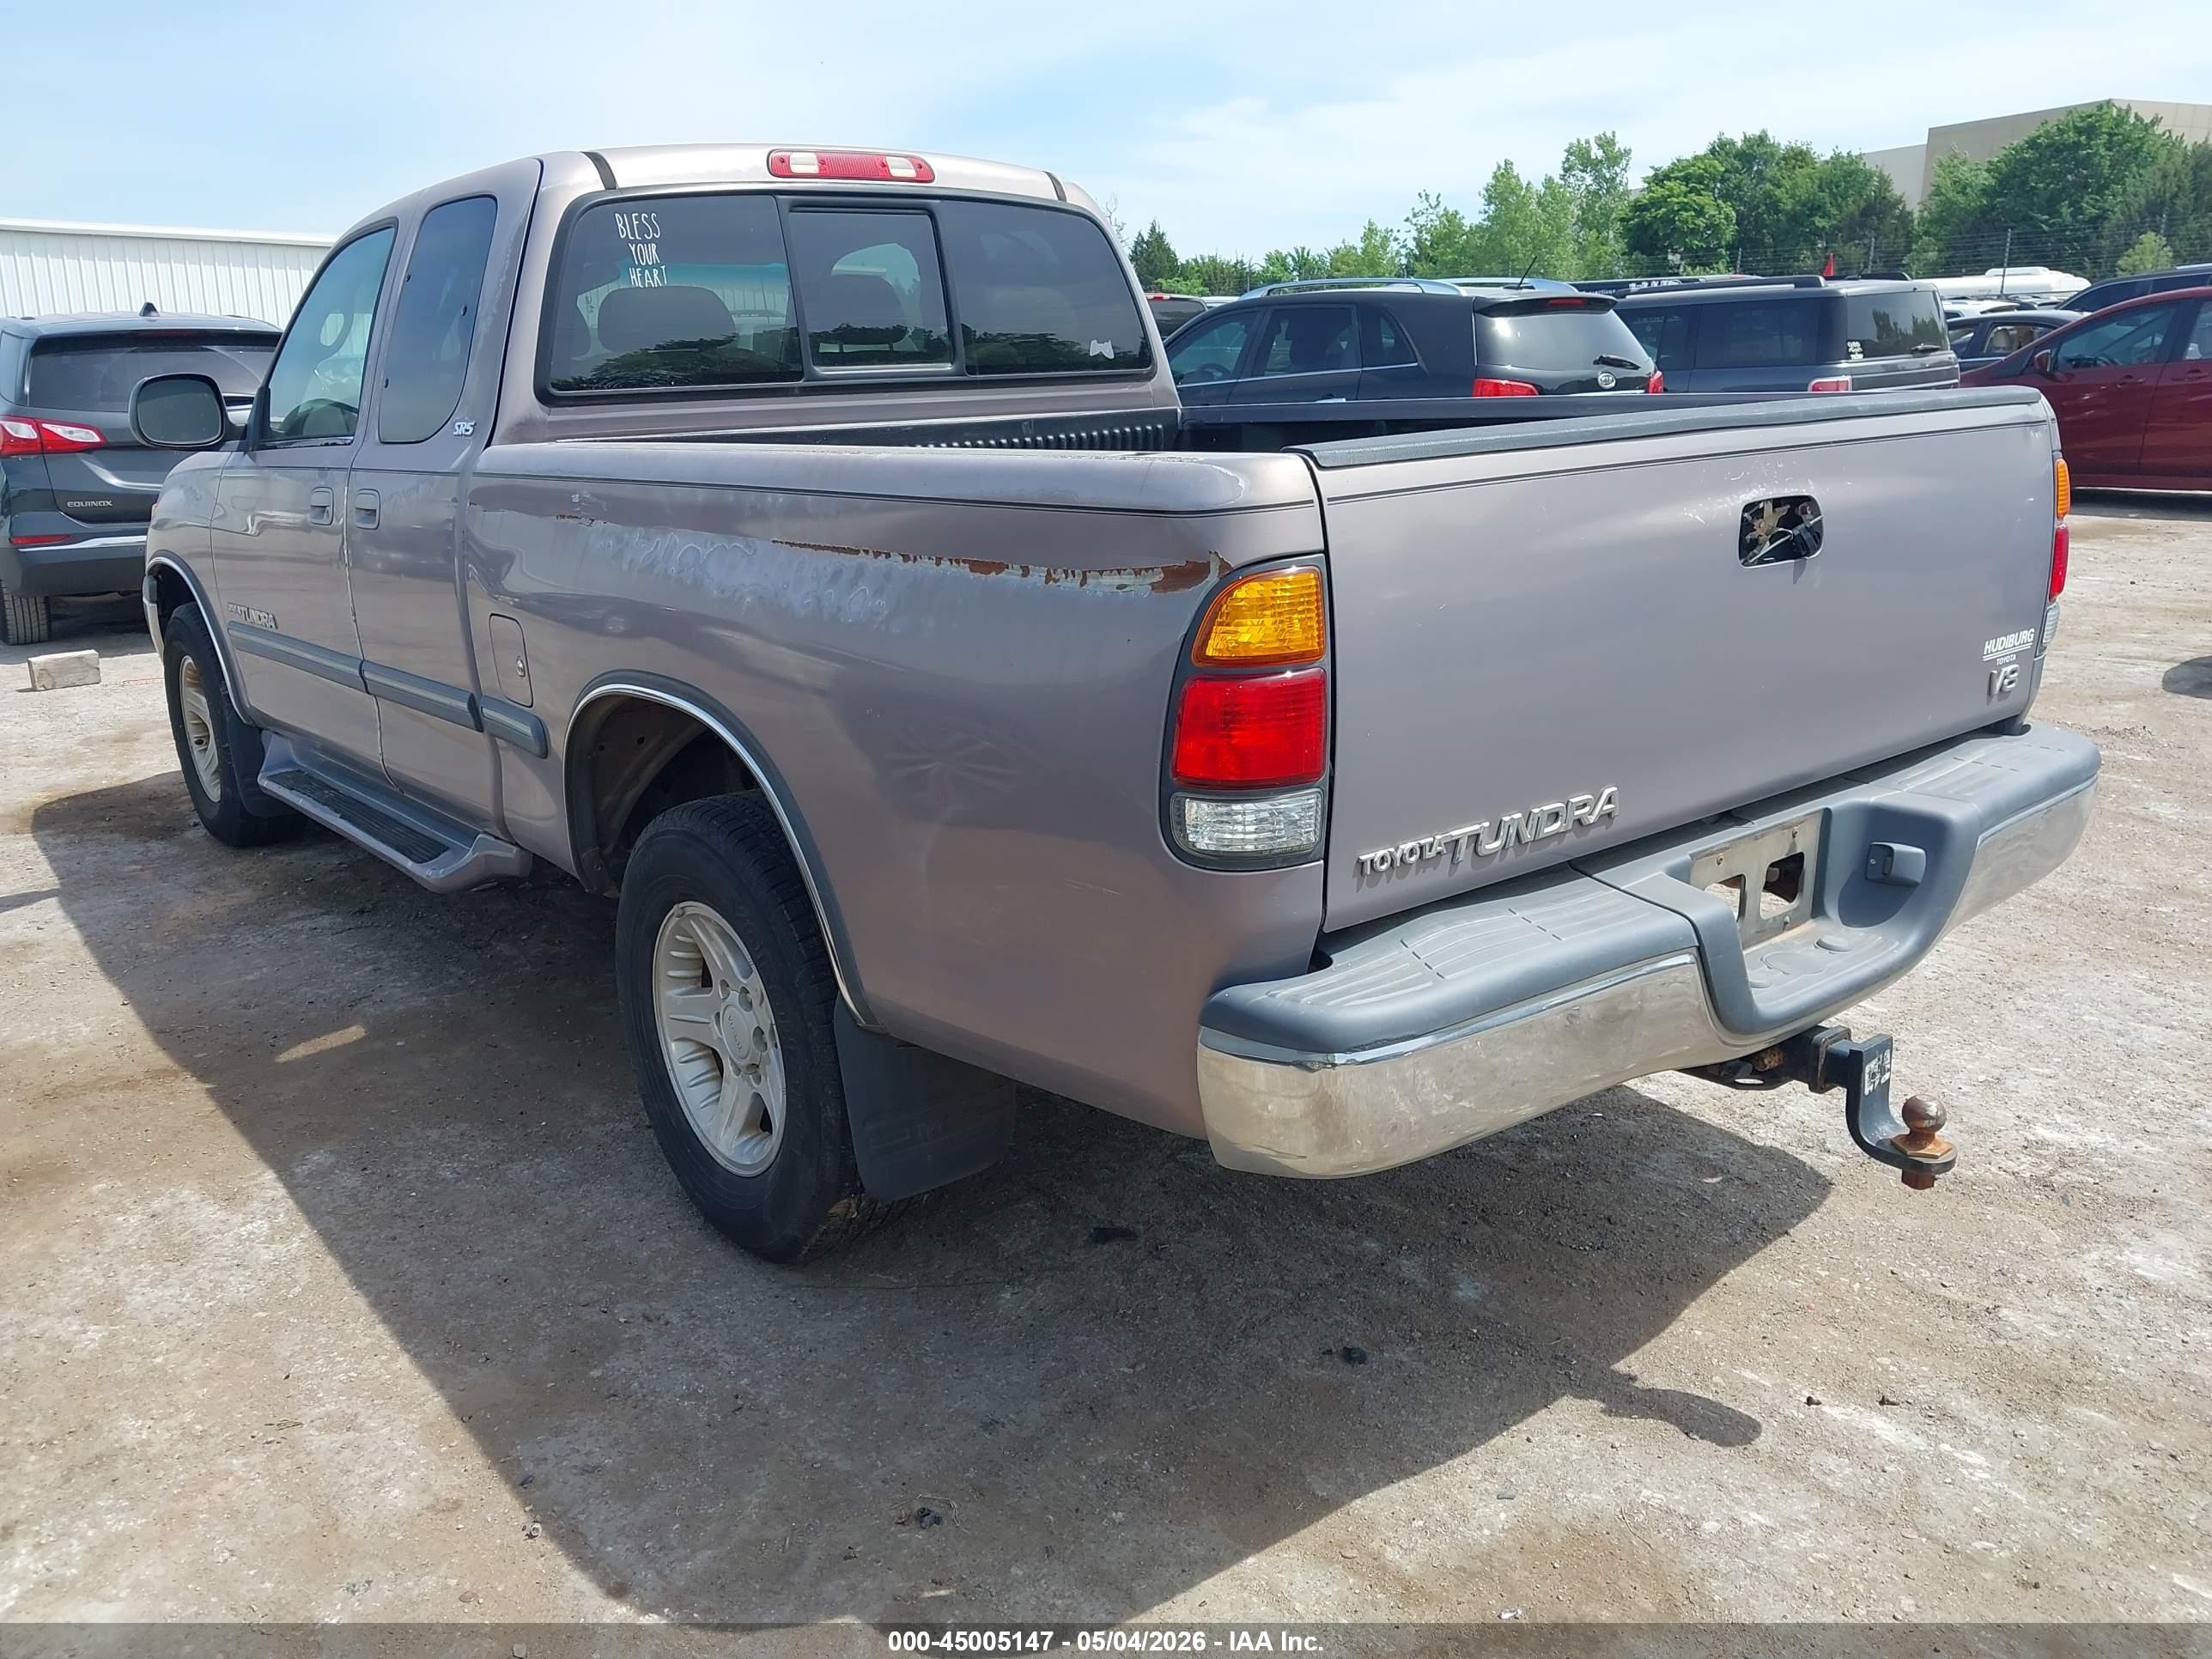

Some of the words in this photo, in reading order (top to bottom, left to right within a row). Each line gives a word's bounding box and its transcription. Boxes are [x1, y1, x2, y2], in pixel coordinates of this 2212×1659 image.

[615, 213, 660, 240] BLESS
[629, 243, 659, 265] YOUR
[629, 264, 667, 288] HEART
[453, 422, 475, 435] SR5
[1984, 629, 2034, 654] HUDIBURG
[1996, 653, 2016, 665] TOYOTA
[1989, 664, 2020, 695] V8
[1358, 835, 1448, 875] TOYOTA
[1449, 787, 1620, 865] TUNDRA
